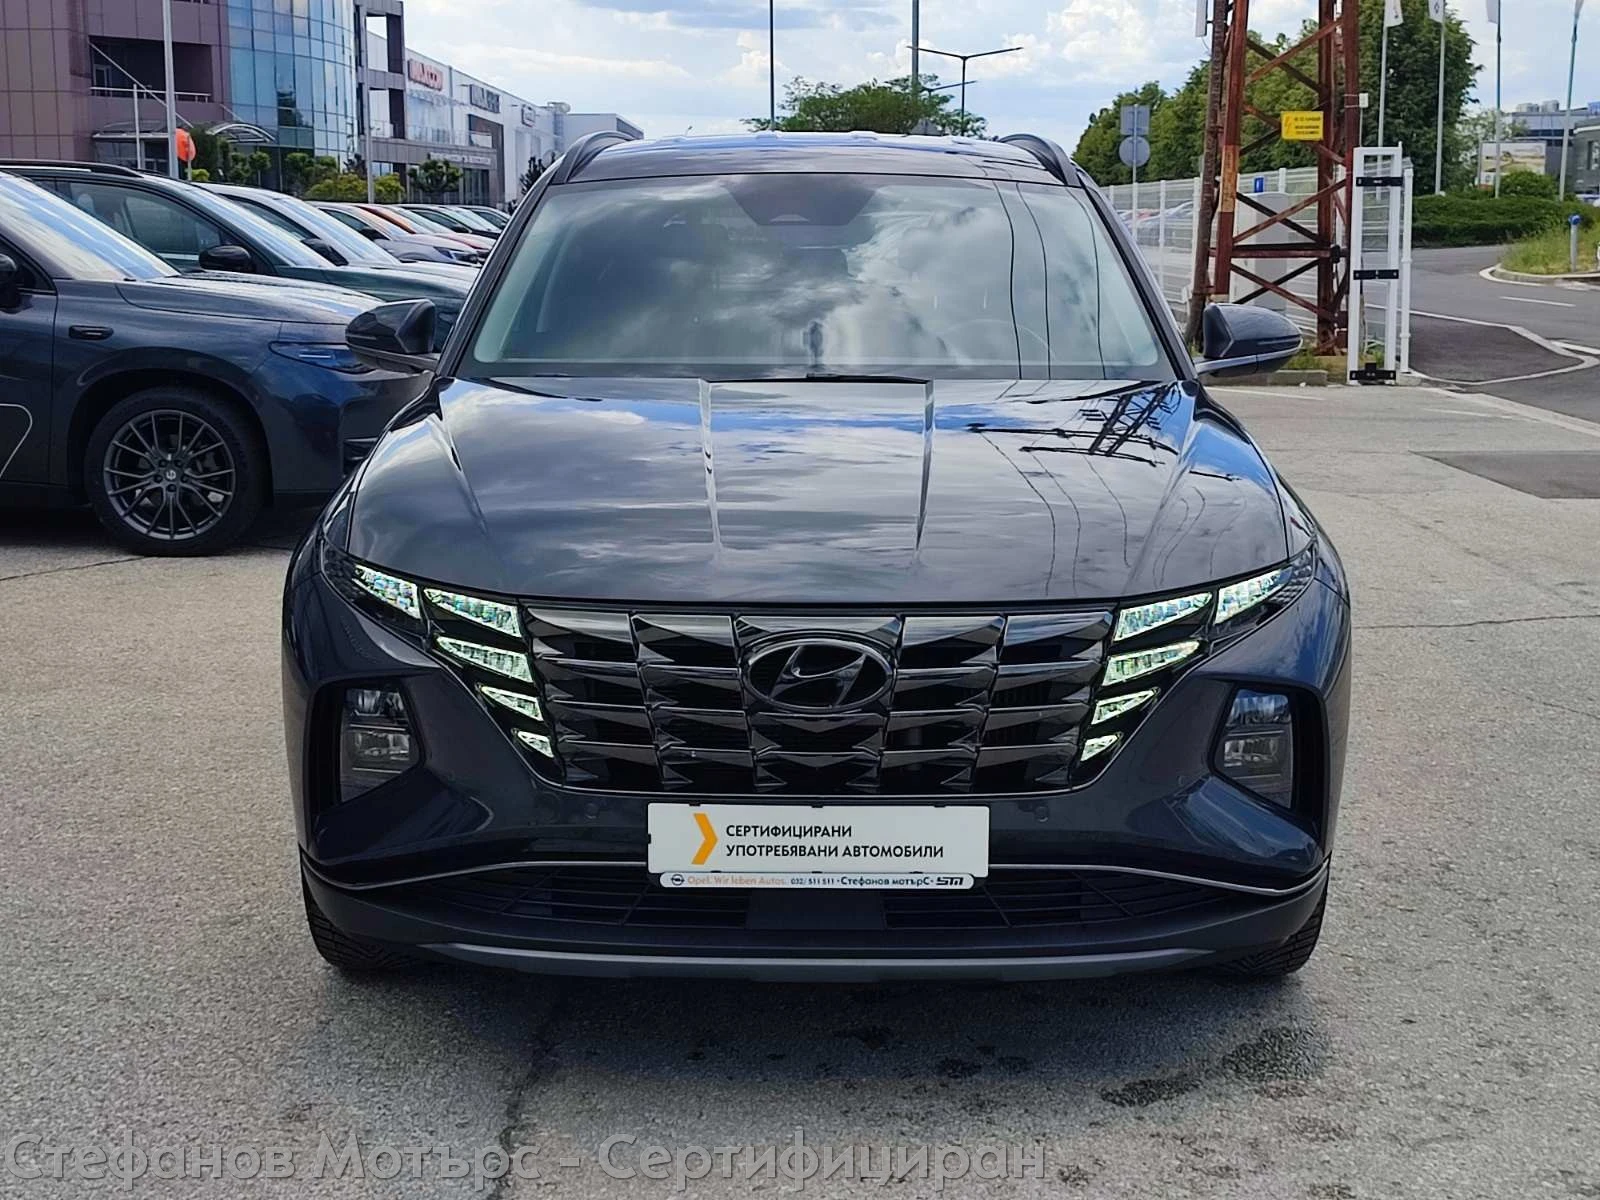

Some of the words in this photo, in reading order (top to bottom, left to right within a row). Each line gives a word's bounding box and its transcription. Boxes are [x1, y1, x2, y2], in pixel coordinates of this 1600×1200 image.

[725, 824, 852, 839] СЕРТИФИЦИРАНИ
[726, 845, 838, 857] УПОТРЕБЯВАНИ
[842, 845, 944, 857] АВТОМОБИЛИ
